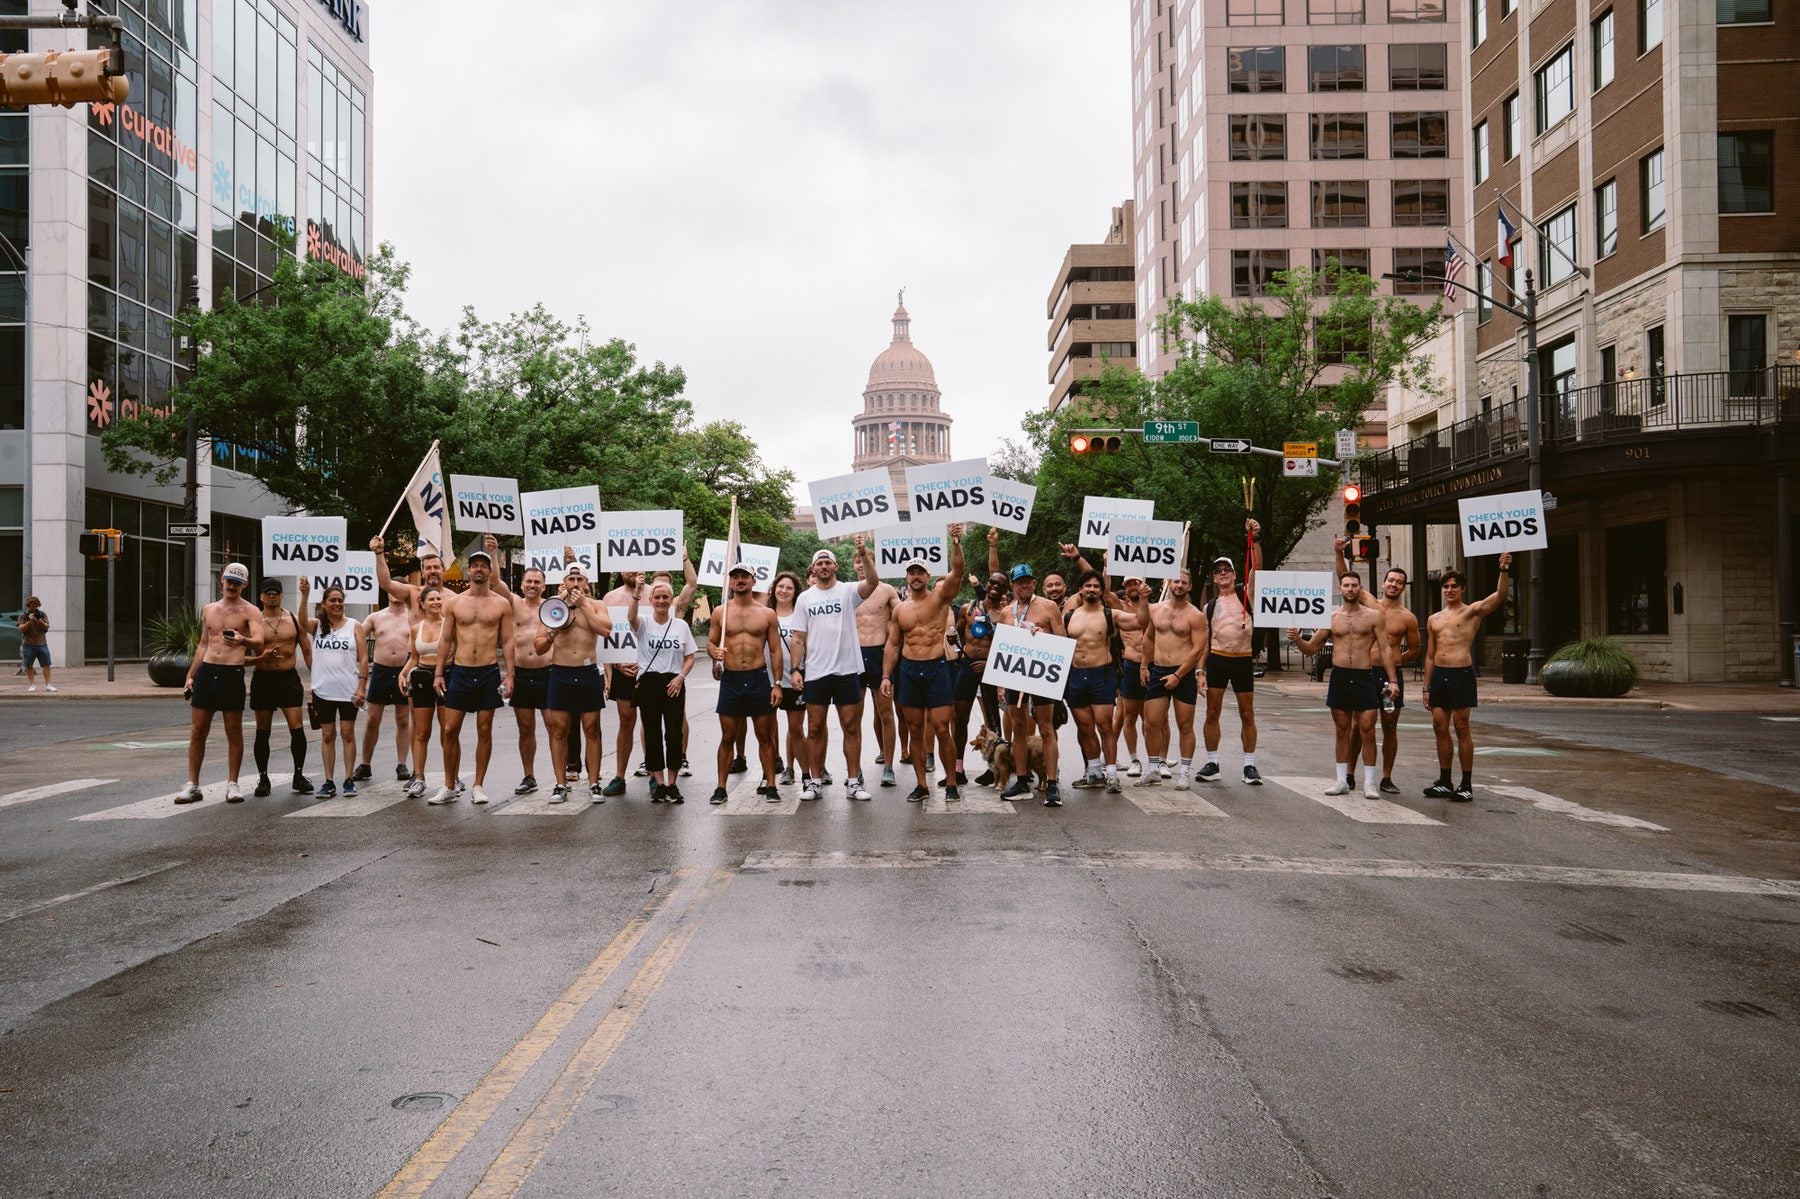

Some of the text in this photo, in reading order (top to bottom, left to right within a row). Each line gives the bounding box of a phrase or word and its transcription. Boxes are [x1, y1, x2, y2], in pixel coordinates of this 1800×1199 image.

[121, 104, 196, 172] curative
[323, 241, 365, 279] curative
[1155, 423, 1175, 434] 9th
[1625, 447, 1650, 460] 901
[914, 476, 983, 493] CHECK YOUR
[1450, 467, 1504, 492] FOUNDATION
[458, 491, 514, 503] CHECK YOUR
[818, 484, 886, 505] CHECK YOUR
[915, 486, 985, 512] NADS
[1006, 495, 1028, 506] YOUR
[459, 501, 515, 521] NADS
[530, 503, 594, 517] CHECK YOUR
[820, 494, 889, 524] NADS
[1088, 511, 1118, 519] CHECK
[1467, 507, 1537, 523] CHECK YOUR
[531, 512, 596, 536] NADS
[608, 527, 676, 537] CHECK YOUR
[1469, 517, 1538, 542] NADS
[272, 533, 340, 544] CHECK YOUR
[608, 537, 676, 557] NADS
[880, 536, 941, 547] CHECK YOUR
[1115, 534, 1176, 546] CHECK YOUR
[272, 543, 339, 562] NADS
[573, 546, 592, 555] OUR
[881, 545, 942, 564] NADS
[1114, 544, 1175, 565] NADS
[531, 554, 592, 572] NAS
[744, 556, 771, 566] YOUR
[347, 566, 374, 574] YOUR
[706, 560, 769, 580] NS
[313, 575, 373, 591] NADS
[1261, 587, 1326, 596] CHECK YOUR
[808, 603, 842, 617] NADS
[1261, 596, 1325, 615] NADS
[315, 639, 349, 650] NADS
[603, 632, 637, 649] NA
[648, 639, 680, 650] NADS
[998, 642, 1065, 664] CHECK YOUR
[993, 651, 1062, 683] NADS
